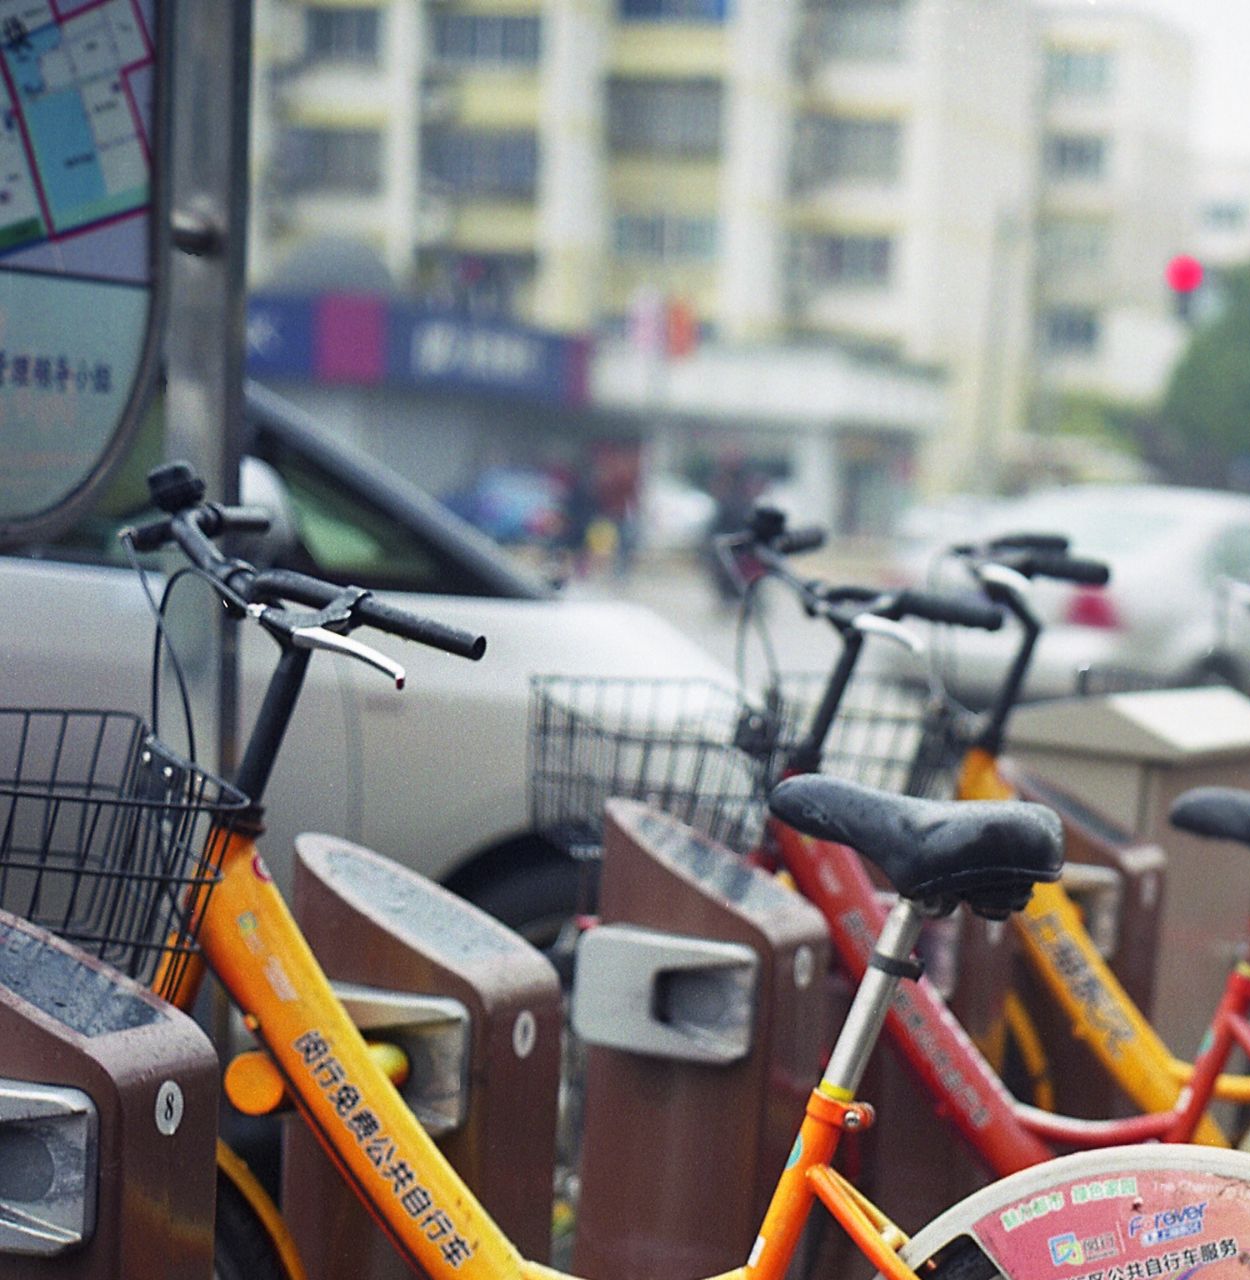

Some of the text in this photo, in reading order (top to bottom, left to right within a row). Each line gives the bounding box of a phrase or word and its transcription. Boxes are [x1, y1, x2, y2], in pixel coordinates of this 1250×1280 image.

[164, 1091, 175, 1121] 8
[293, 1030, 473, 1270] 闵行免费公共自行车
[1128, 1202, 1208, 1237] Forever
